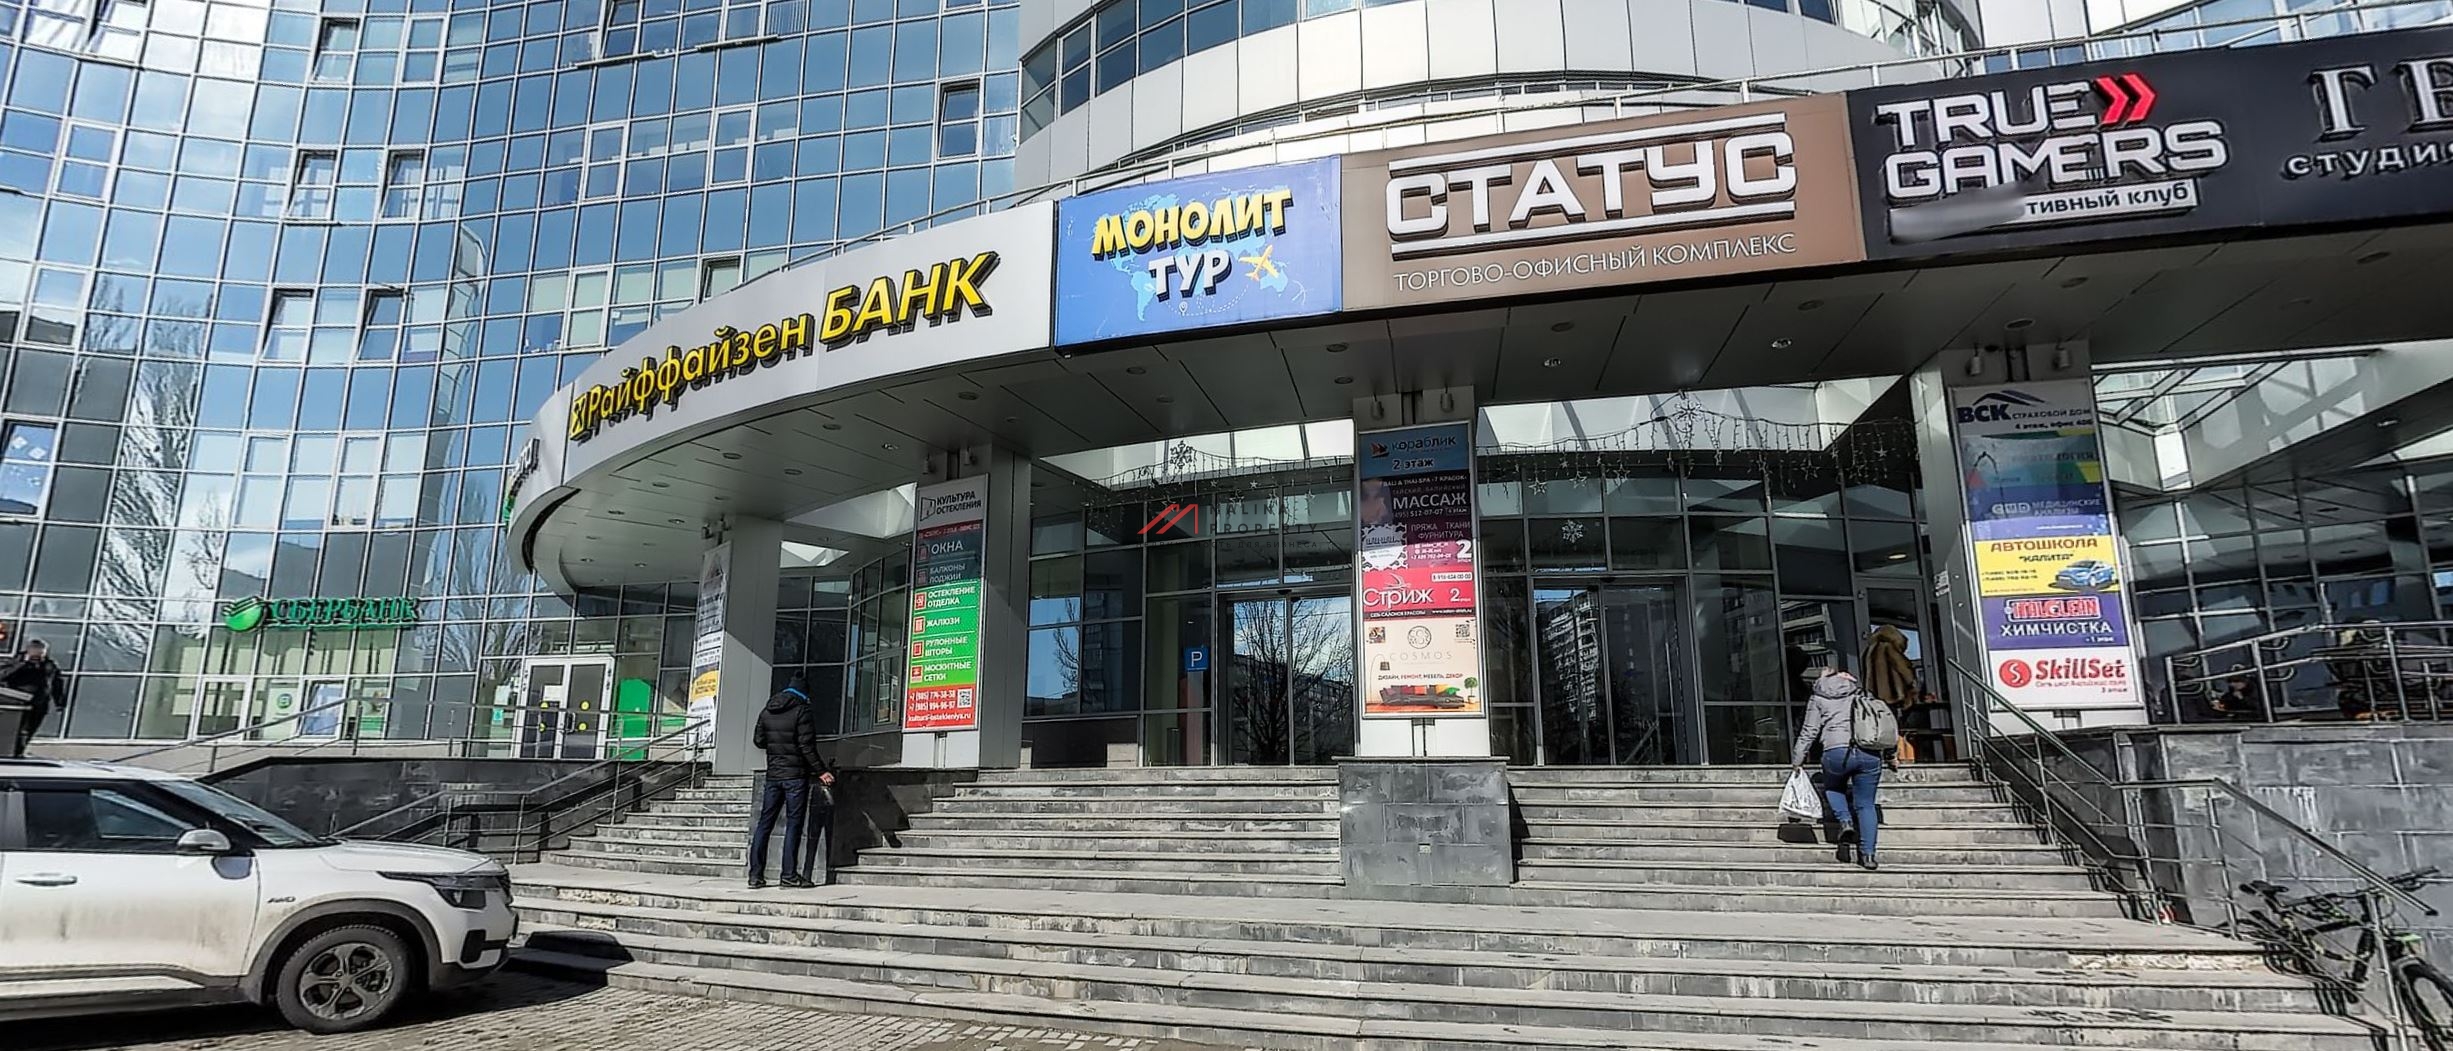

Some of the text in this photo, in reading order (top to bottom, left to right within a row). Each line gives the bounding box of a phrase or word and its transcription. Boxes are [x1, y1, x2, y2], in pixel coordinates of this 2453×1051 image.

[1876, 80, 2097, 146] TRUE
[1885, 119, 2227, 199] GAMERS
[2286, 142, 2453, 176] студи
[1386, 131, 1798, 239] СТАТУС
[2126, 182, 2189, 207] клуб
[1092, 188, 1293, 257] МОНОЛИТ
[1393, 233, 1797, 292] ТОРГОВО-ОФИСНЫЙ КОМПЛЕКС
[1149, 250, 1231, 298] ТУР
[586, 251, 998, 432] Райффайзен БАНК
[1956, 403, 2091, 423] ВСК СТРАХОВОЙ ДОМ
[1391, 436, 1457, 452] кораблик
[1393, 459, 1434, 470] 2 этаж
[936, 491, 976, 506] КУЛЬТУРА
[1393, 492, 1467, 510] МАССАЖ
[936, 500, 982, 515] ОСТЕКЛЕНИЯ
[1445, 521, 1471, 530] ТКАНИ
[931, 540, 964, 555] ОКНА
[1456, 539, 1472, 559] 2
[1991, 537, 2098, 553] АВТОШКОЛА
[929, 563, 966, 575] БАЛКОНЫ
[929, 572, 962, 584] ЛОДЖИИ
[928, 586, 976, 598] ОСТЕКЛЕНИЕ
[1362, 588, 1435, 609] Стриж
[1450, 588, 1460, 602] 2
[270, 598, 420, 620] СБЕРБАНК
[927, 596, 960, 608] ОТДЕЛКА
[925, 616, 961, 628] ЖАЛЮЗИ
[2001, 621, 2113, 637] ХИМЧИСТКА
[925, 636, 968, 648] РУЛОННЫЕ
[924, 646, 953, 657] ШТОРЫ
[1191, 651, 1203, 668] P
[1389, 650, 1453, 661] COSMOS
[924, 660, 972, 673] МОСКИТНЫЕ
[2035, 657, 2126, 680] SkillSet
[923, 672, 947, 682] СЕТКИ
